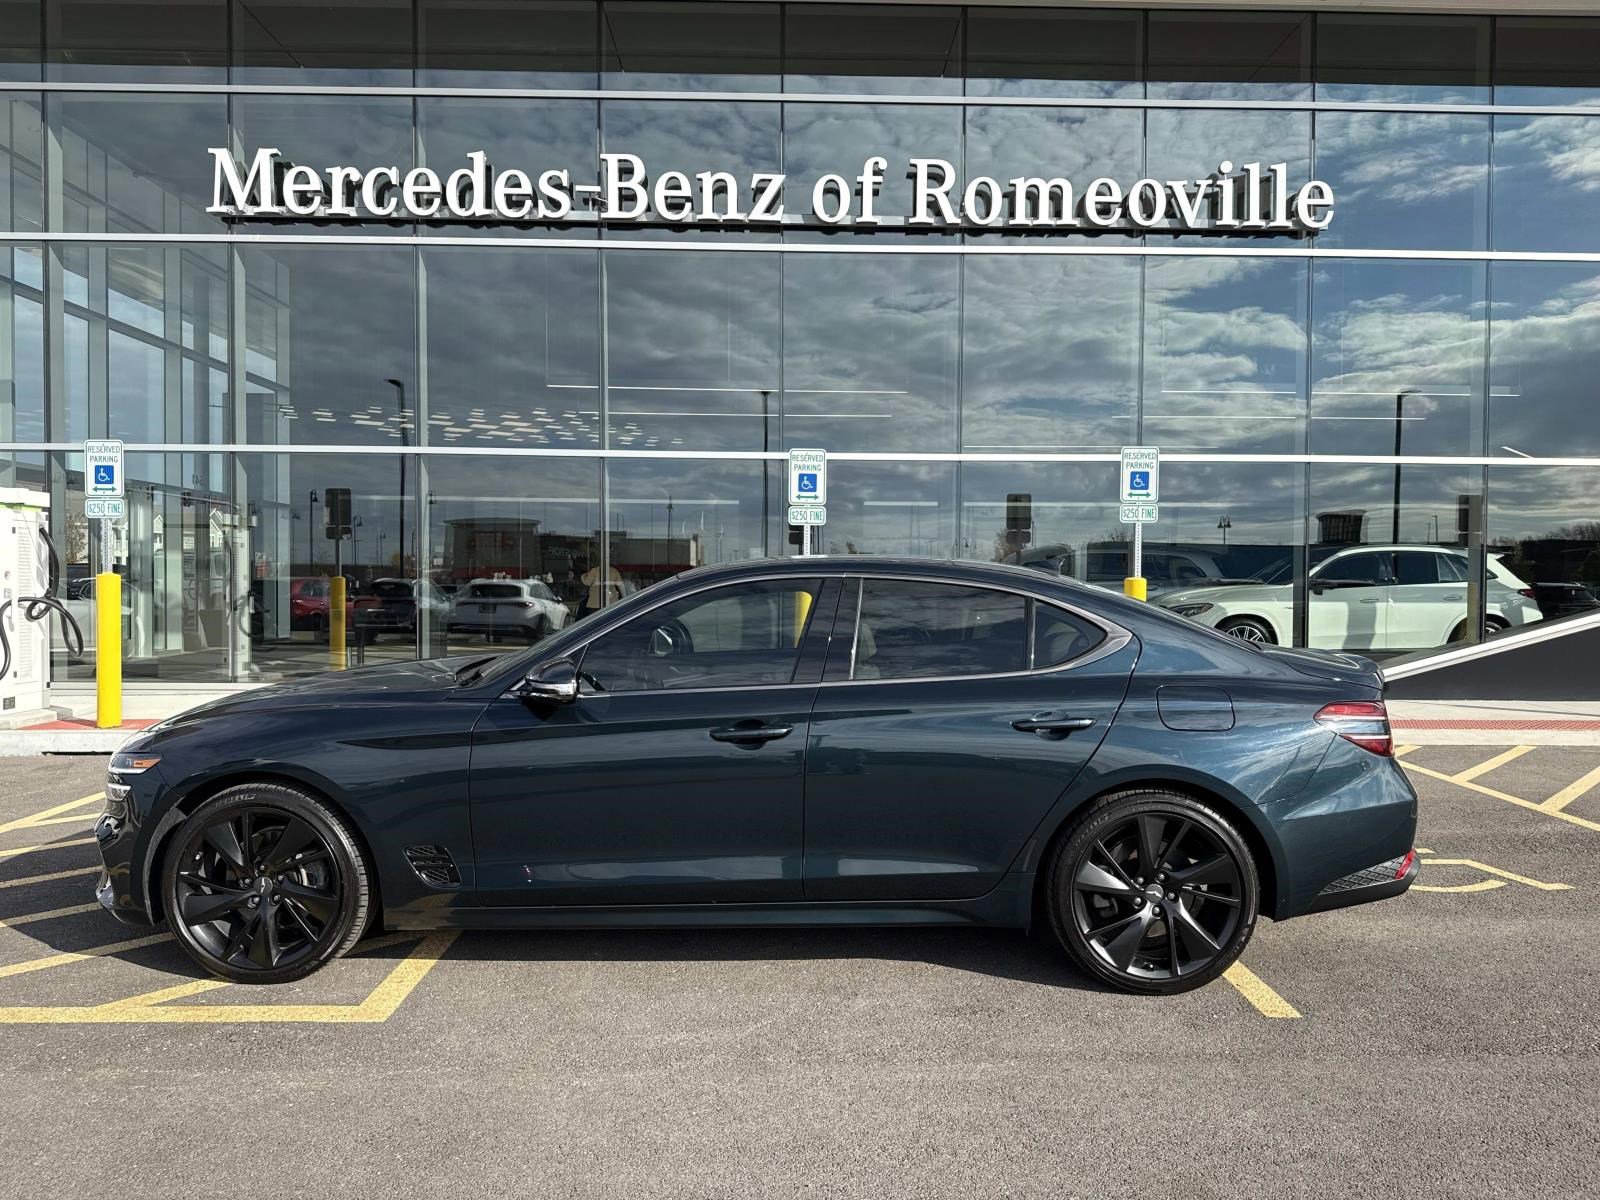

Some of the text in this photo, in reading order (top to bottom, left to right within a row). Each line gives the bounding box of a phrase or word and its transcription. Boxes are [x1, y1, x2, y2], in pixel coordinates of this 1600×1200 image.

[207, 148, 1336, 229] Mercedes-Benz of Romeoville
[87, 446, 121, 454] RESERVED
[791, 454, 824, 462] RESERVED
[1124, 452, 1156, 460] RESERVED
[793, 464, 822, 472] PARKING
[1125, 462, 1154, 470] PARKING
[88, 503, 121, 514] $250 FINE
[791, 510, 823, 521] $250 FINE
[1123, 508, 1156, 519] $250 FINE
